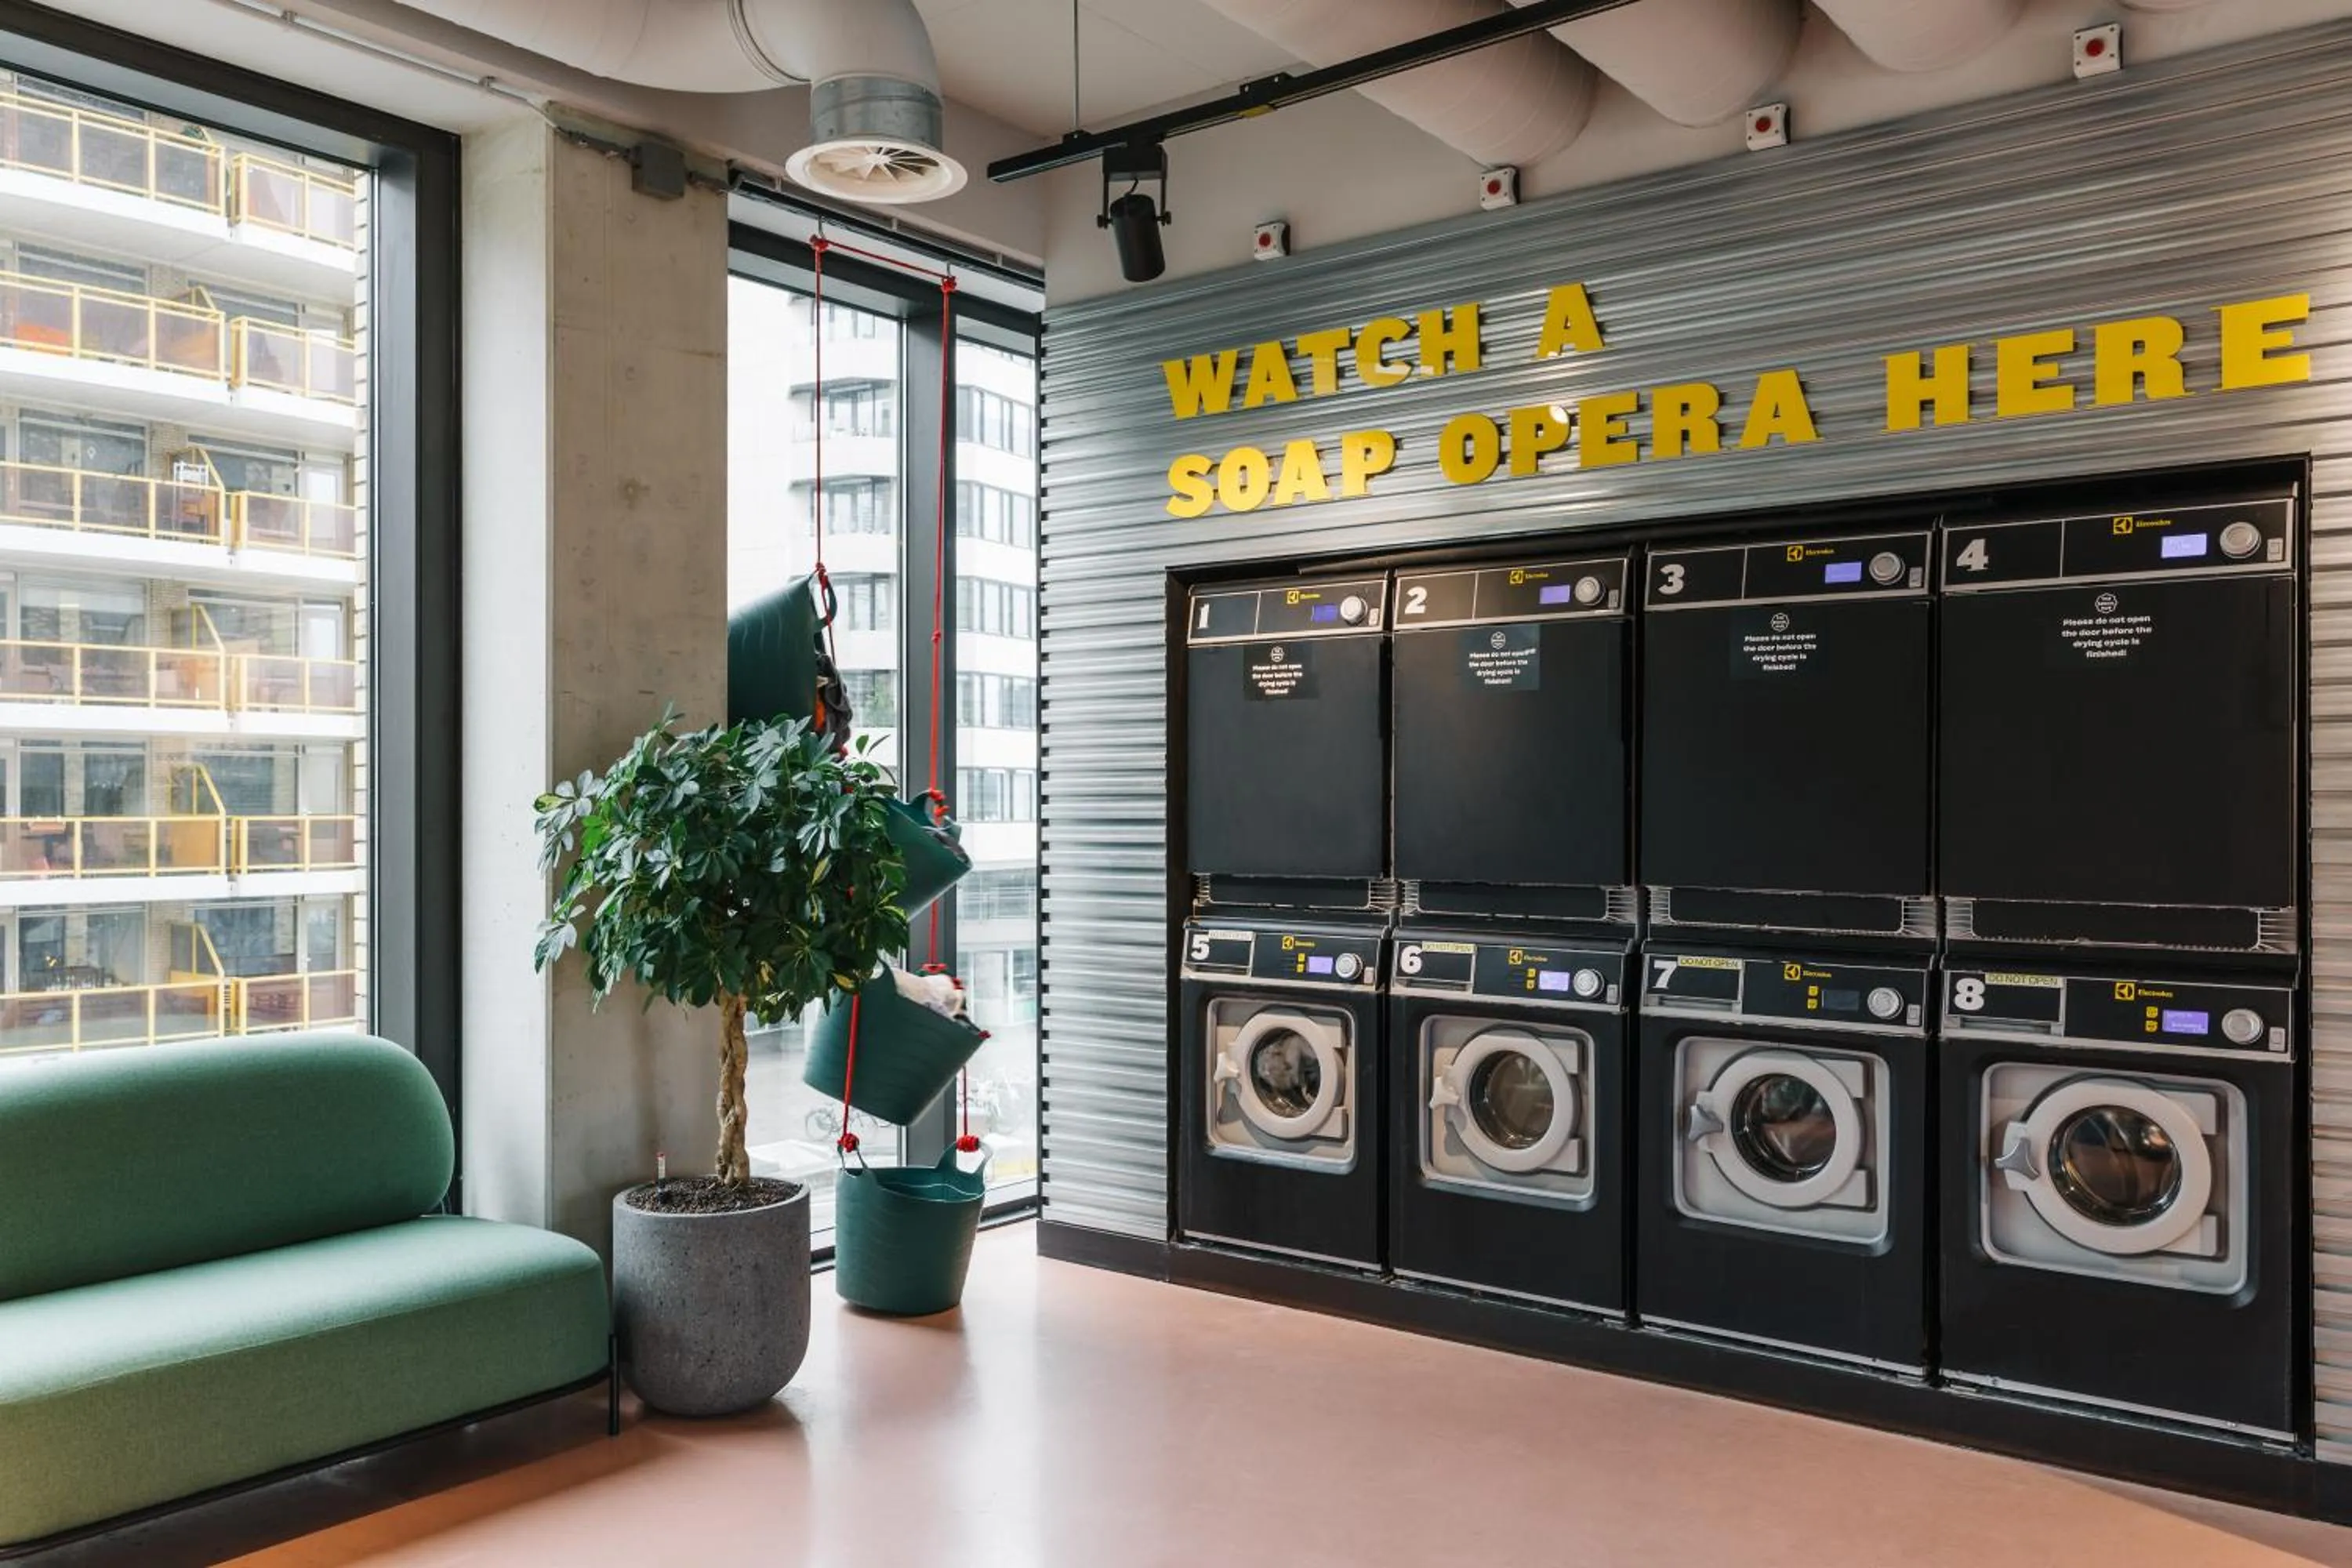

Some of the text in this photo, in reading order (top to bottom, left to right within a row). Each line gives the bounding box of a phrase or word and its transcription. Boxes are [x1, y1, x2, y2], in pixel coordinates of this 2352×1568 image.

[1160, 282, 1607, 420] WATCH A
[1165, 293, 2311, 519] SOAP OPERA HERE
[1956, 538, 1990, 572] 4
[1658, 564, 1685, 595] 3
[1404, 586, 1428, 614] 2
[1198, 603, 1210, 629] 1
[2063, 618, 2093, 626] Please
[2126, 615, 2151, 624] open
[2072, 639, 2103, 648] drying
[2131, 637, 2140, 645] is
[2102, 626, 2134, 635] before
[2136, 626, 2152, 634] the
[1191, 934, 1210, 960] 5
[1400, 945, 1423, 974] 6
[1652, 960, 1678, 989] 7
[1695, 957, 1711, 966] NOT
[1988, 973, 2058, 985] DO NOT OPEN
[1955, 978, 1985, 1011] 8
